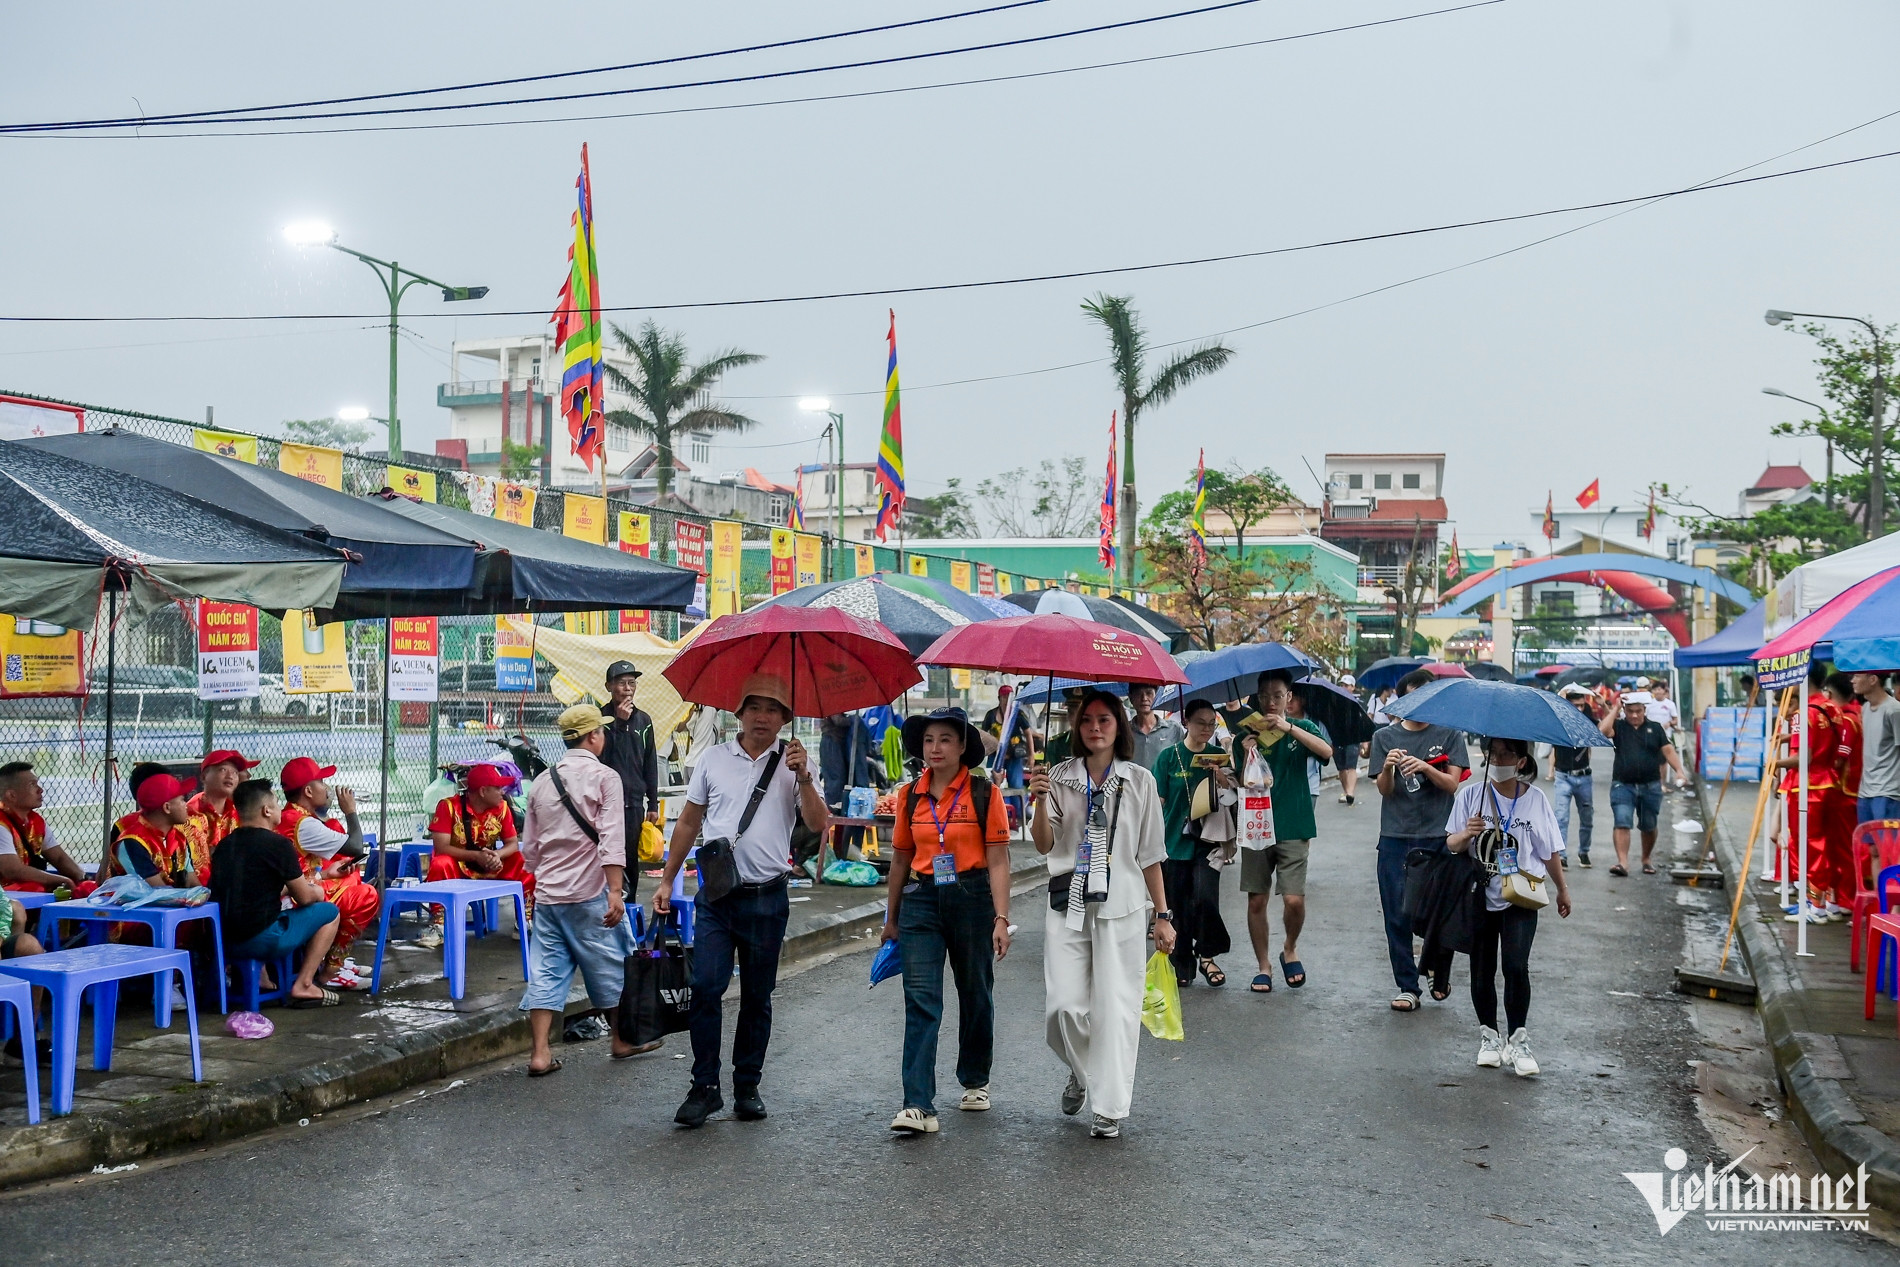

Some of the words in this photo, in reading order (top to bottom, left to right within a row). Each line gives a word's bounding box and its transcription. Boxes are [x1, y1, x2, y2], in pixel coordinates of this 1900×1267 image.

[207, 609, 231, 626] QUỐC
[394, 618, 413, 633] QUỐC
[209, 631, 229, 646] NĂM
[232, 633, 250, 645] 2024
[395, 638, 412, 650] NĂM
[414, 640, 430, 651] 2024
[1093, 643, 1110, 653] ĐẠI
[1112, 645, 1130, 655] HỘI
[219, 657, 245, 667] VICEM
[403, 660, 426, 668] VICEM
[515, 662, 527, 672] Data
